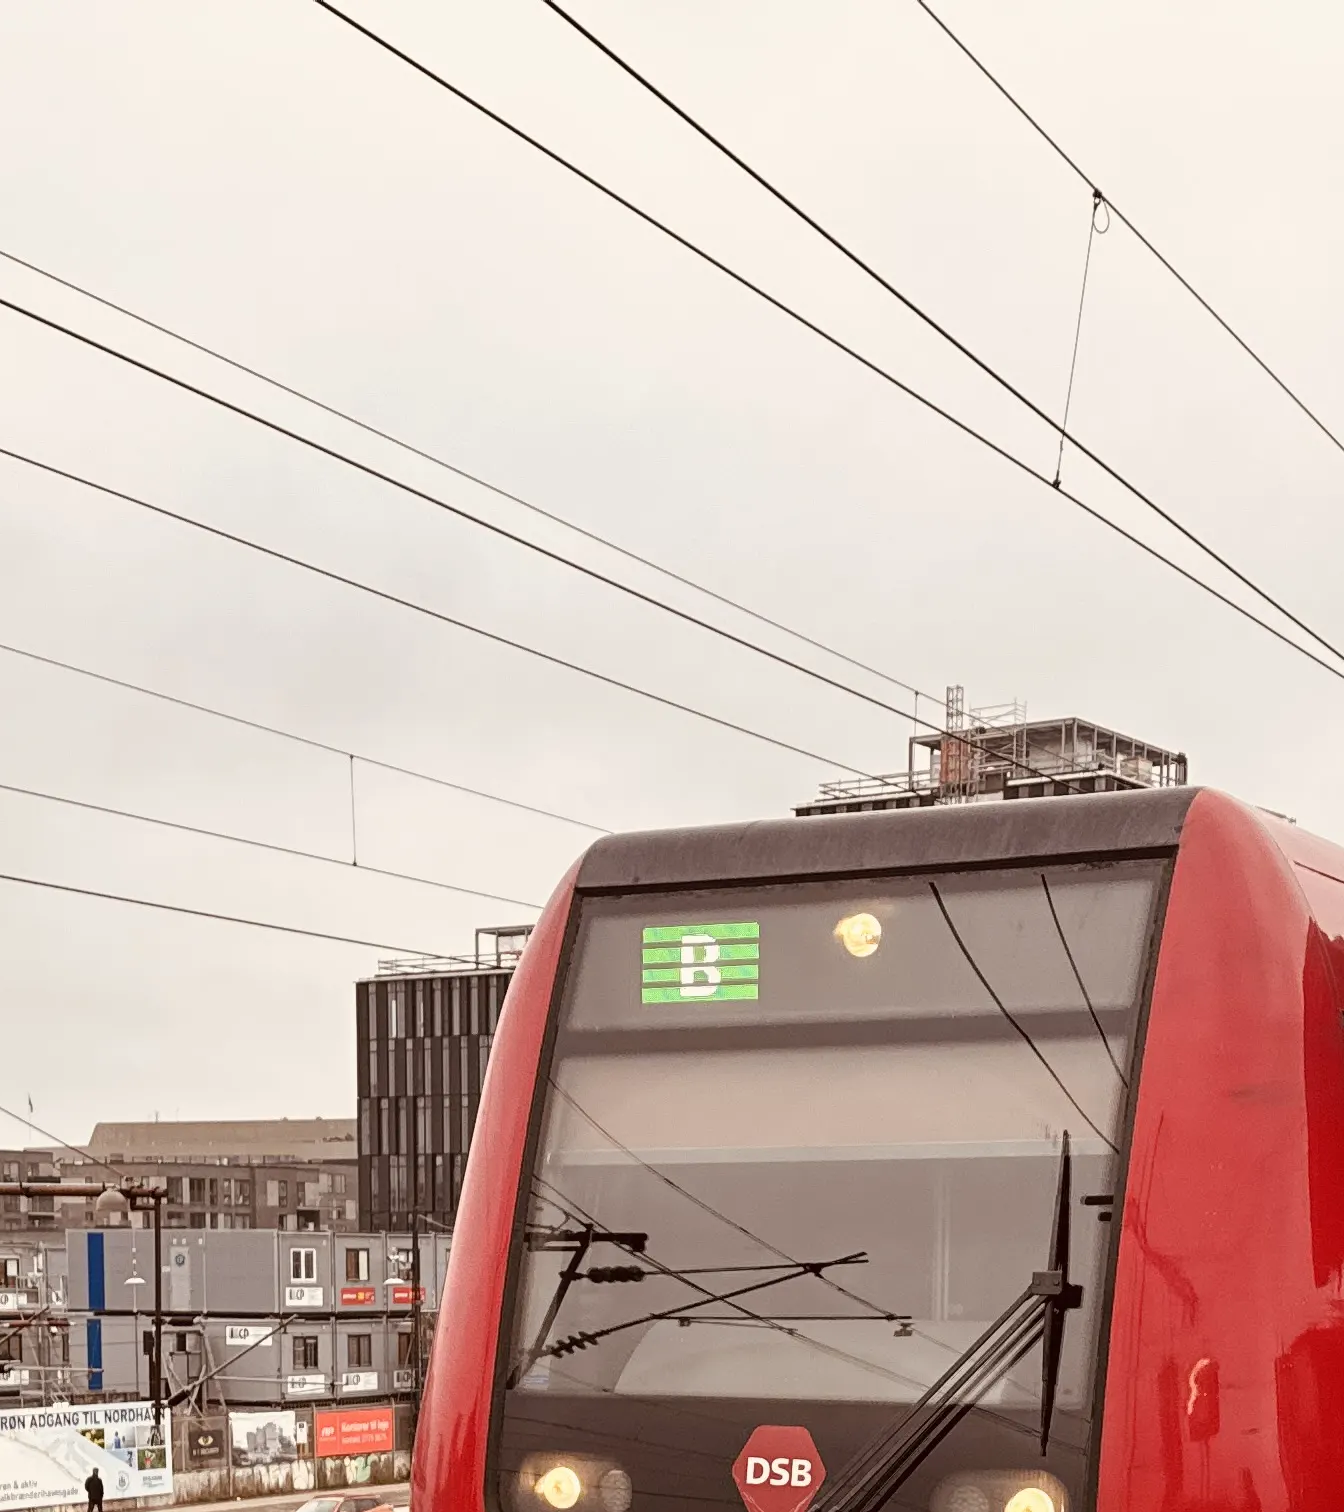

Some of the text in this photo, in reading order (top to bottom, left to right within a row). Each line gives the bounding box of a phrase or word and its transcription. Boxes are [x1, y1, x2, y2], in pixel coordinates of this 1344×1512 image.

[680, 934, 722, 997] B
[30, 1412, 80, 1428] ADGANG
[83, 1410, 100, 1426] TIL
[746, 1456, 812, 1487] DSB
